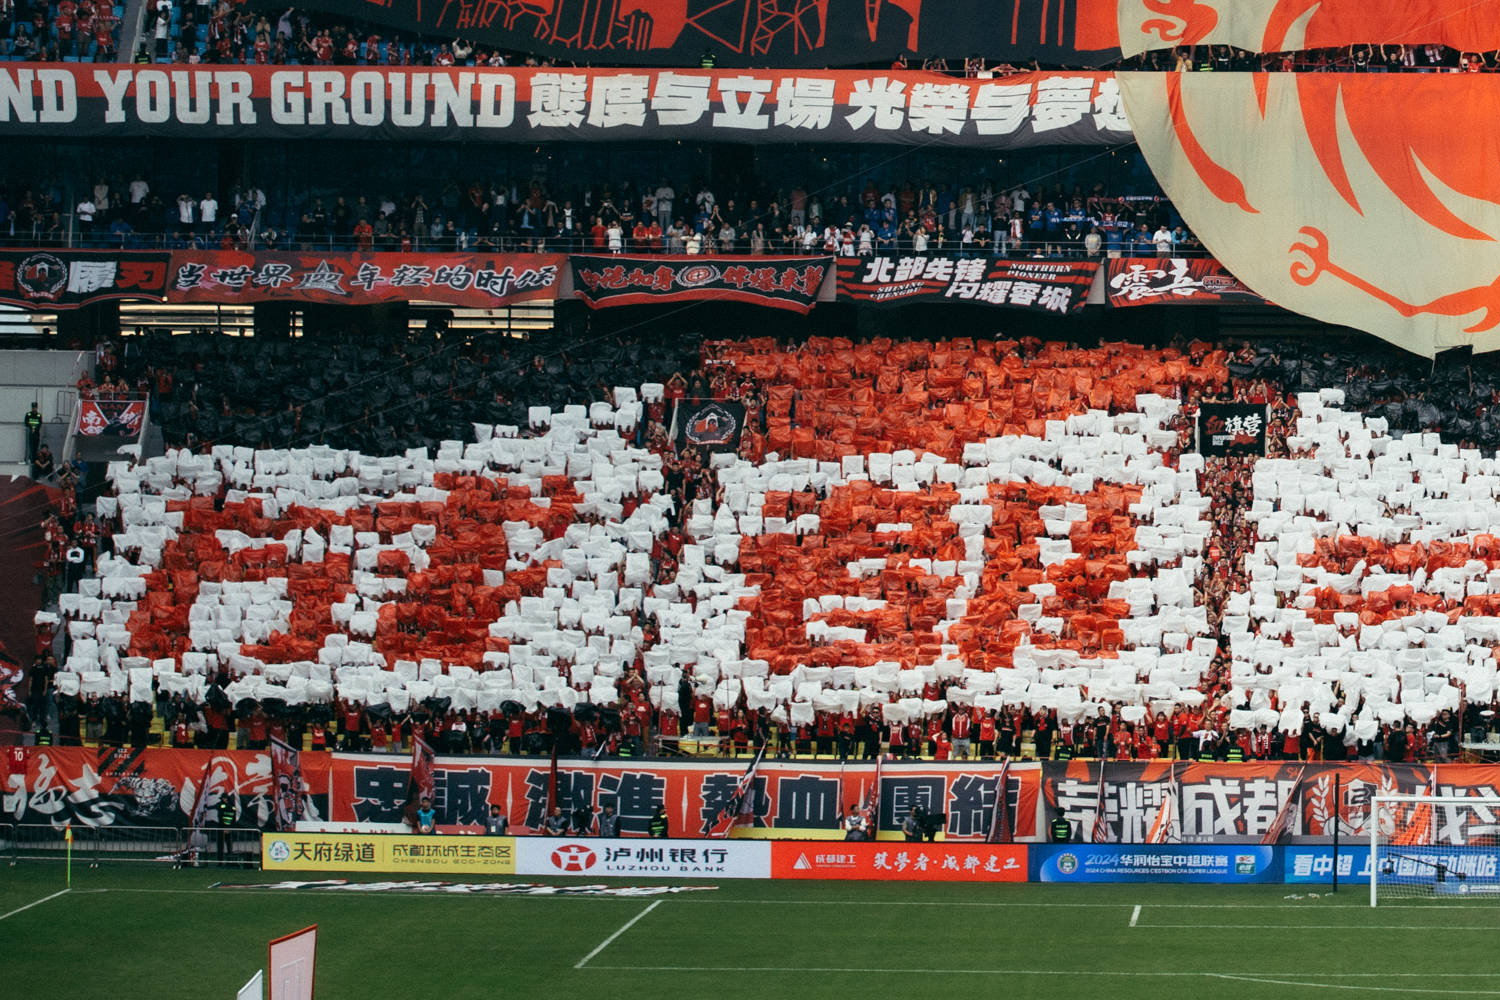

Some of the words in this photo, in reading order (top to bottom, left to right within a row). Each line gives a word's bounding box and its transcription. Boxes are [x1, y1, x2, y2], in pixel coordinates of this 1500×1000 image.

[93, 69, 256, 126] YOUR
[270, 71, 515, 128] GROUND
[862, 256, 987, 284] 北部先锋
[1007, 270, 1057, 281] PIONEER
[1010, 262, 1072, 273] NORTHERN
[351, 263, 557, 297] 年轻的时候
[945, 280, 1073, 314] 闪耀蓉城
[14, 750, 24, 762] 10
[293, 842, 376, 863] 天府绿道
[392, 844, 511, 858] 成都环城生态区
[605, 847, 728, 864] 泸州银行
[815, 854, 857, 864] 成都建工
[606, 865, 670, 873] LUZHOU
[680, 865, 725, 873] BANK
[1294, 853, 1353, 876] 看中超
